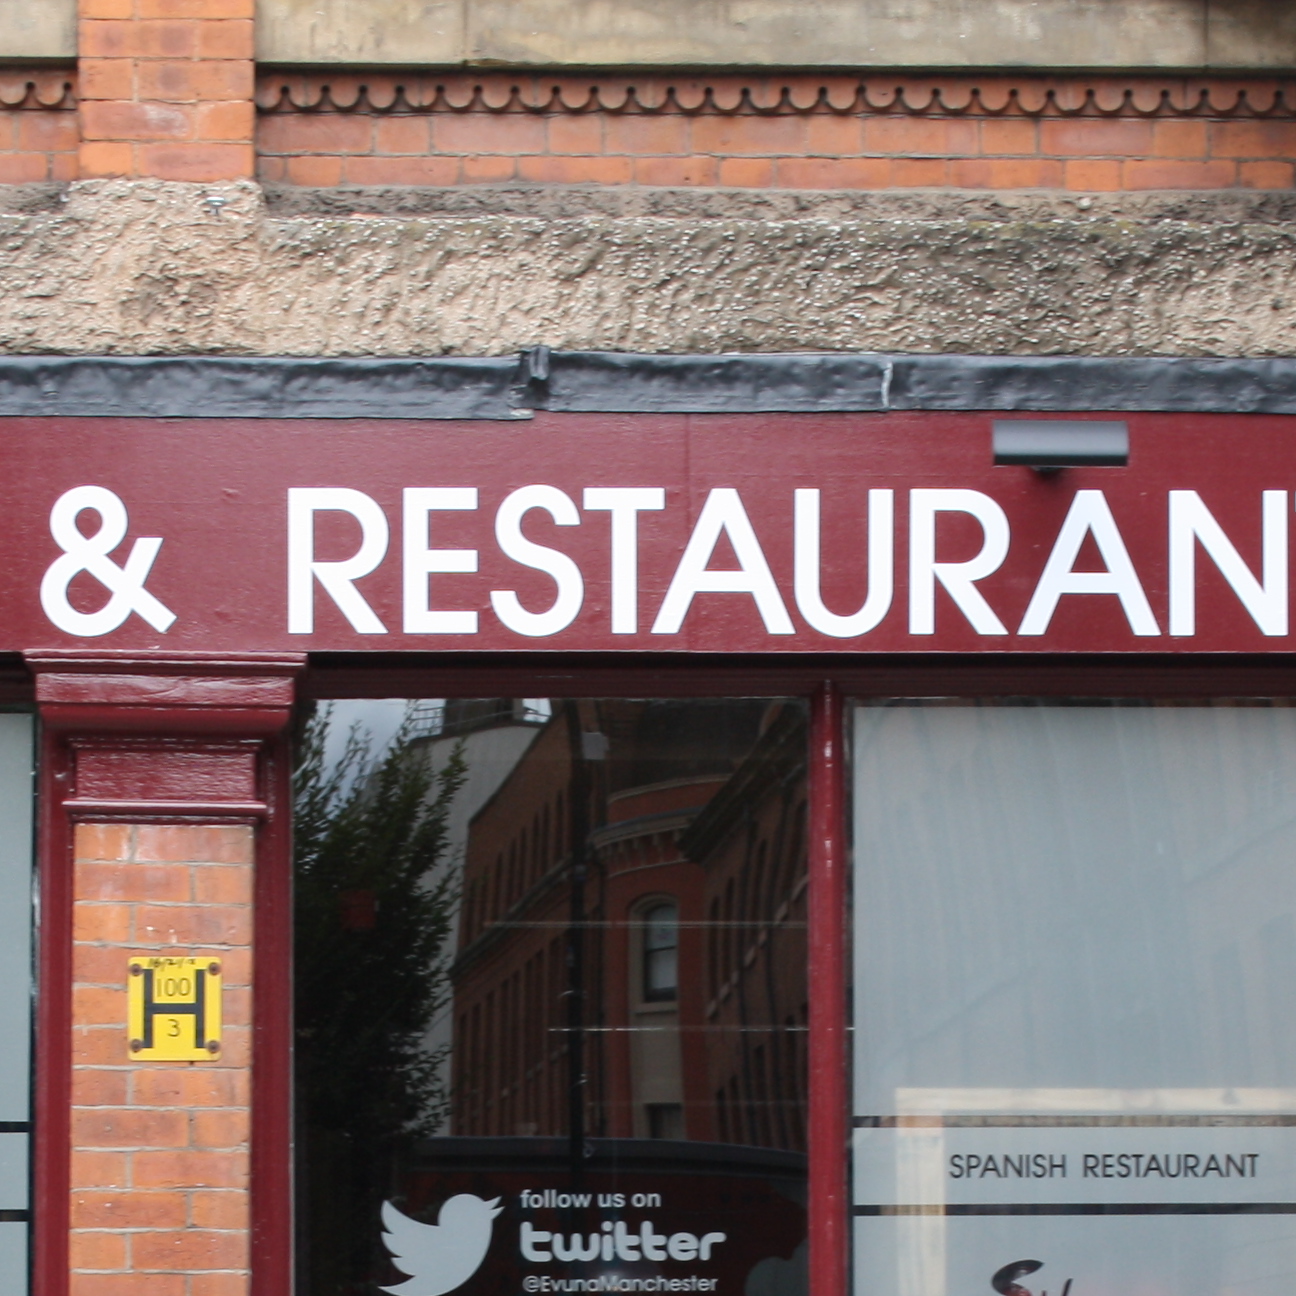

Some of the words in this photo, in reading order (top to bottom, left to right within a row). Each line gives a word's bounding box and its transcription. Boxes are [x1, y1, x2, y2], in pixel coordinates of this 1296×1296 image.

[40, 485, 177, 637] &
[156, 977, 191, 997] 100
[144, 969, 206, 1048] H
[167, 1019, 180, 1037] 3
[949, 1154, 1067, 1178] SPANISH
[1083, 1154, 1259, 1178] RESTAURANT
[520, 1190, 592, 1208] follow
[598, 1193, 626, 1208] us
[631, 1193, 661, 1208] on
[520, 1221, 727, 1262] twitter
[522, 1275, 718, 1293] @EvunaManchester
